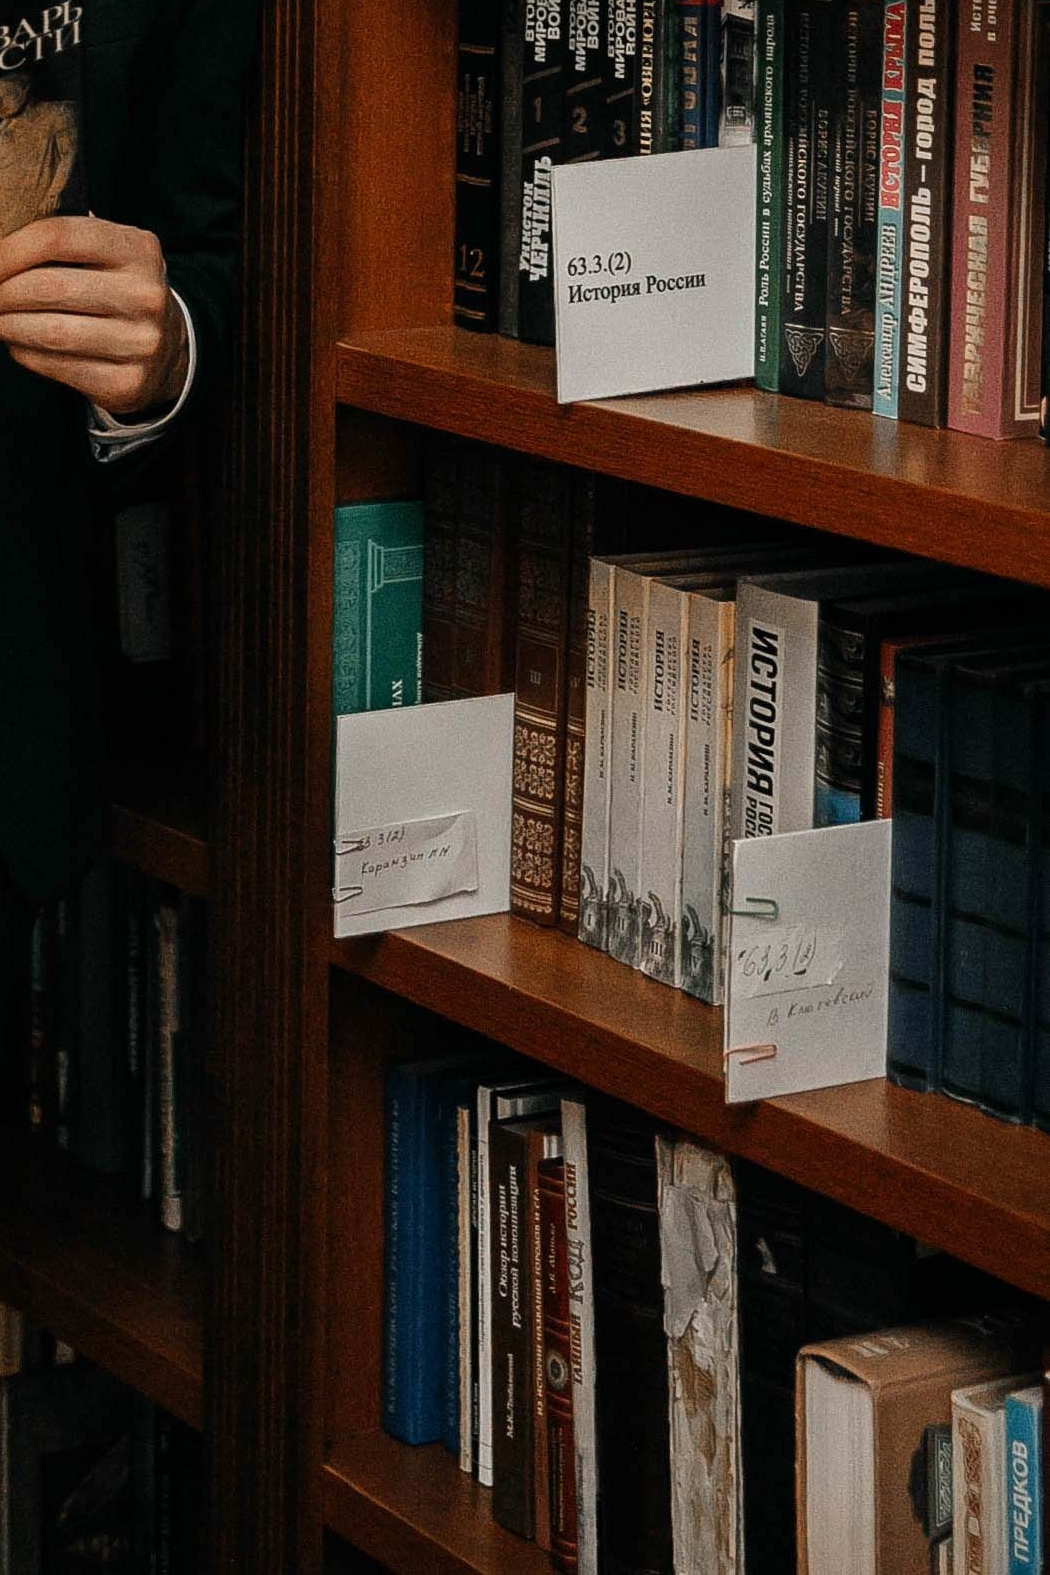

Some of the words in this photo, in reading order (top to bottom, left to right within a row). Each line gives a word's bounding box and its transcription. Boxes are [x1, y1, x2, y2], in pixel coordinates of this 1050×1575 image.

[764, 14, 776, 62] народа
[881, 0, 907, 92] КРЫМА
[571, 104, 589, 135] 2
[612, 119, 628, 146] 3
[763, 65, 775, 146] армянского
[968, 63, 994, 206] ГУБЕРНИЯ
[759, 150, 775, 204] судьбах
[879, 98, 903, 211] ИСТОРИЯ
[519, 182, 534, 272] УИНСТОН
[528, 157, 552, 283] ЧЕРЧИЛЛЬ
[758, 222, 771, 270] России
[793, 204, 808, 312] ГОСУДАРСТВА
[460, 245, 487, 278] 12
[567, 251, 632, 277] 63.3.(2)
[568, 282, 641, 304] История
[645, 273, 707, 295] России
[757, 274, 770, 307] Роль
[840, 206, 856, 316] ГОСУДАРСТВА
[878, 224, 899, 310] АНДРЕЕВ
[906, 187, 931, 394] СИМФЕРОПОЛЬ
[960, 215, 989, 416] ТАВРИЧЕСКАЯ
[876, 313, 895, 401] Александр
[587, 607, 597, 688] ИСТОРИЯ
[617, 610, 628, 691] ИСТОРИЯ
[653, 629, 665, 712] ИСТОРИЯ
[690, 638, 701, 722] ИСТОРИЯ
[746, 626, 779, 797] ИСТОРИЯ
[497, 1184, 510, 1248] истории
[508, 1163, 521, 1264] колонизации
[565, 1161, 579, 1232] РОССИИ
[497, 1249, 511, 1298] Обзор
[509, 1266, 523, 1329] русской
[567, 1240, 586, 1306] КОД
[1011, 1440, 1033, 1563] ПРЕДКОВ
